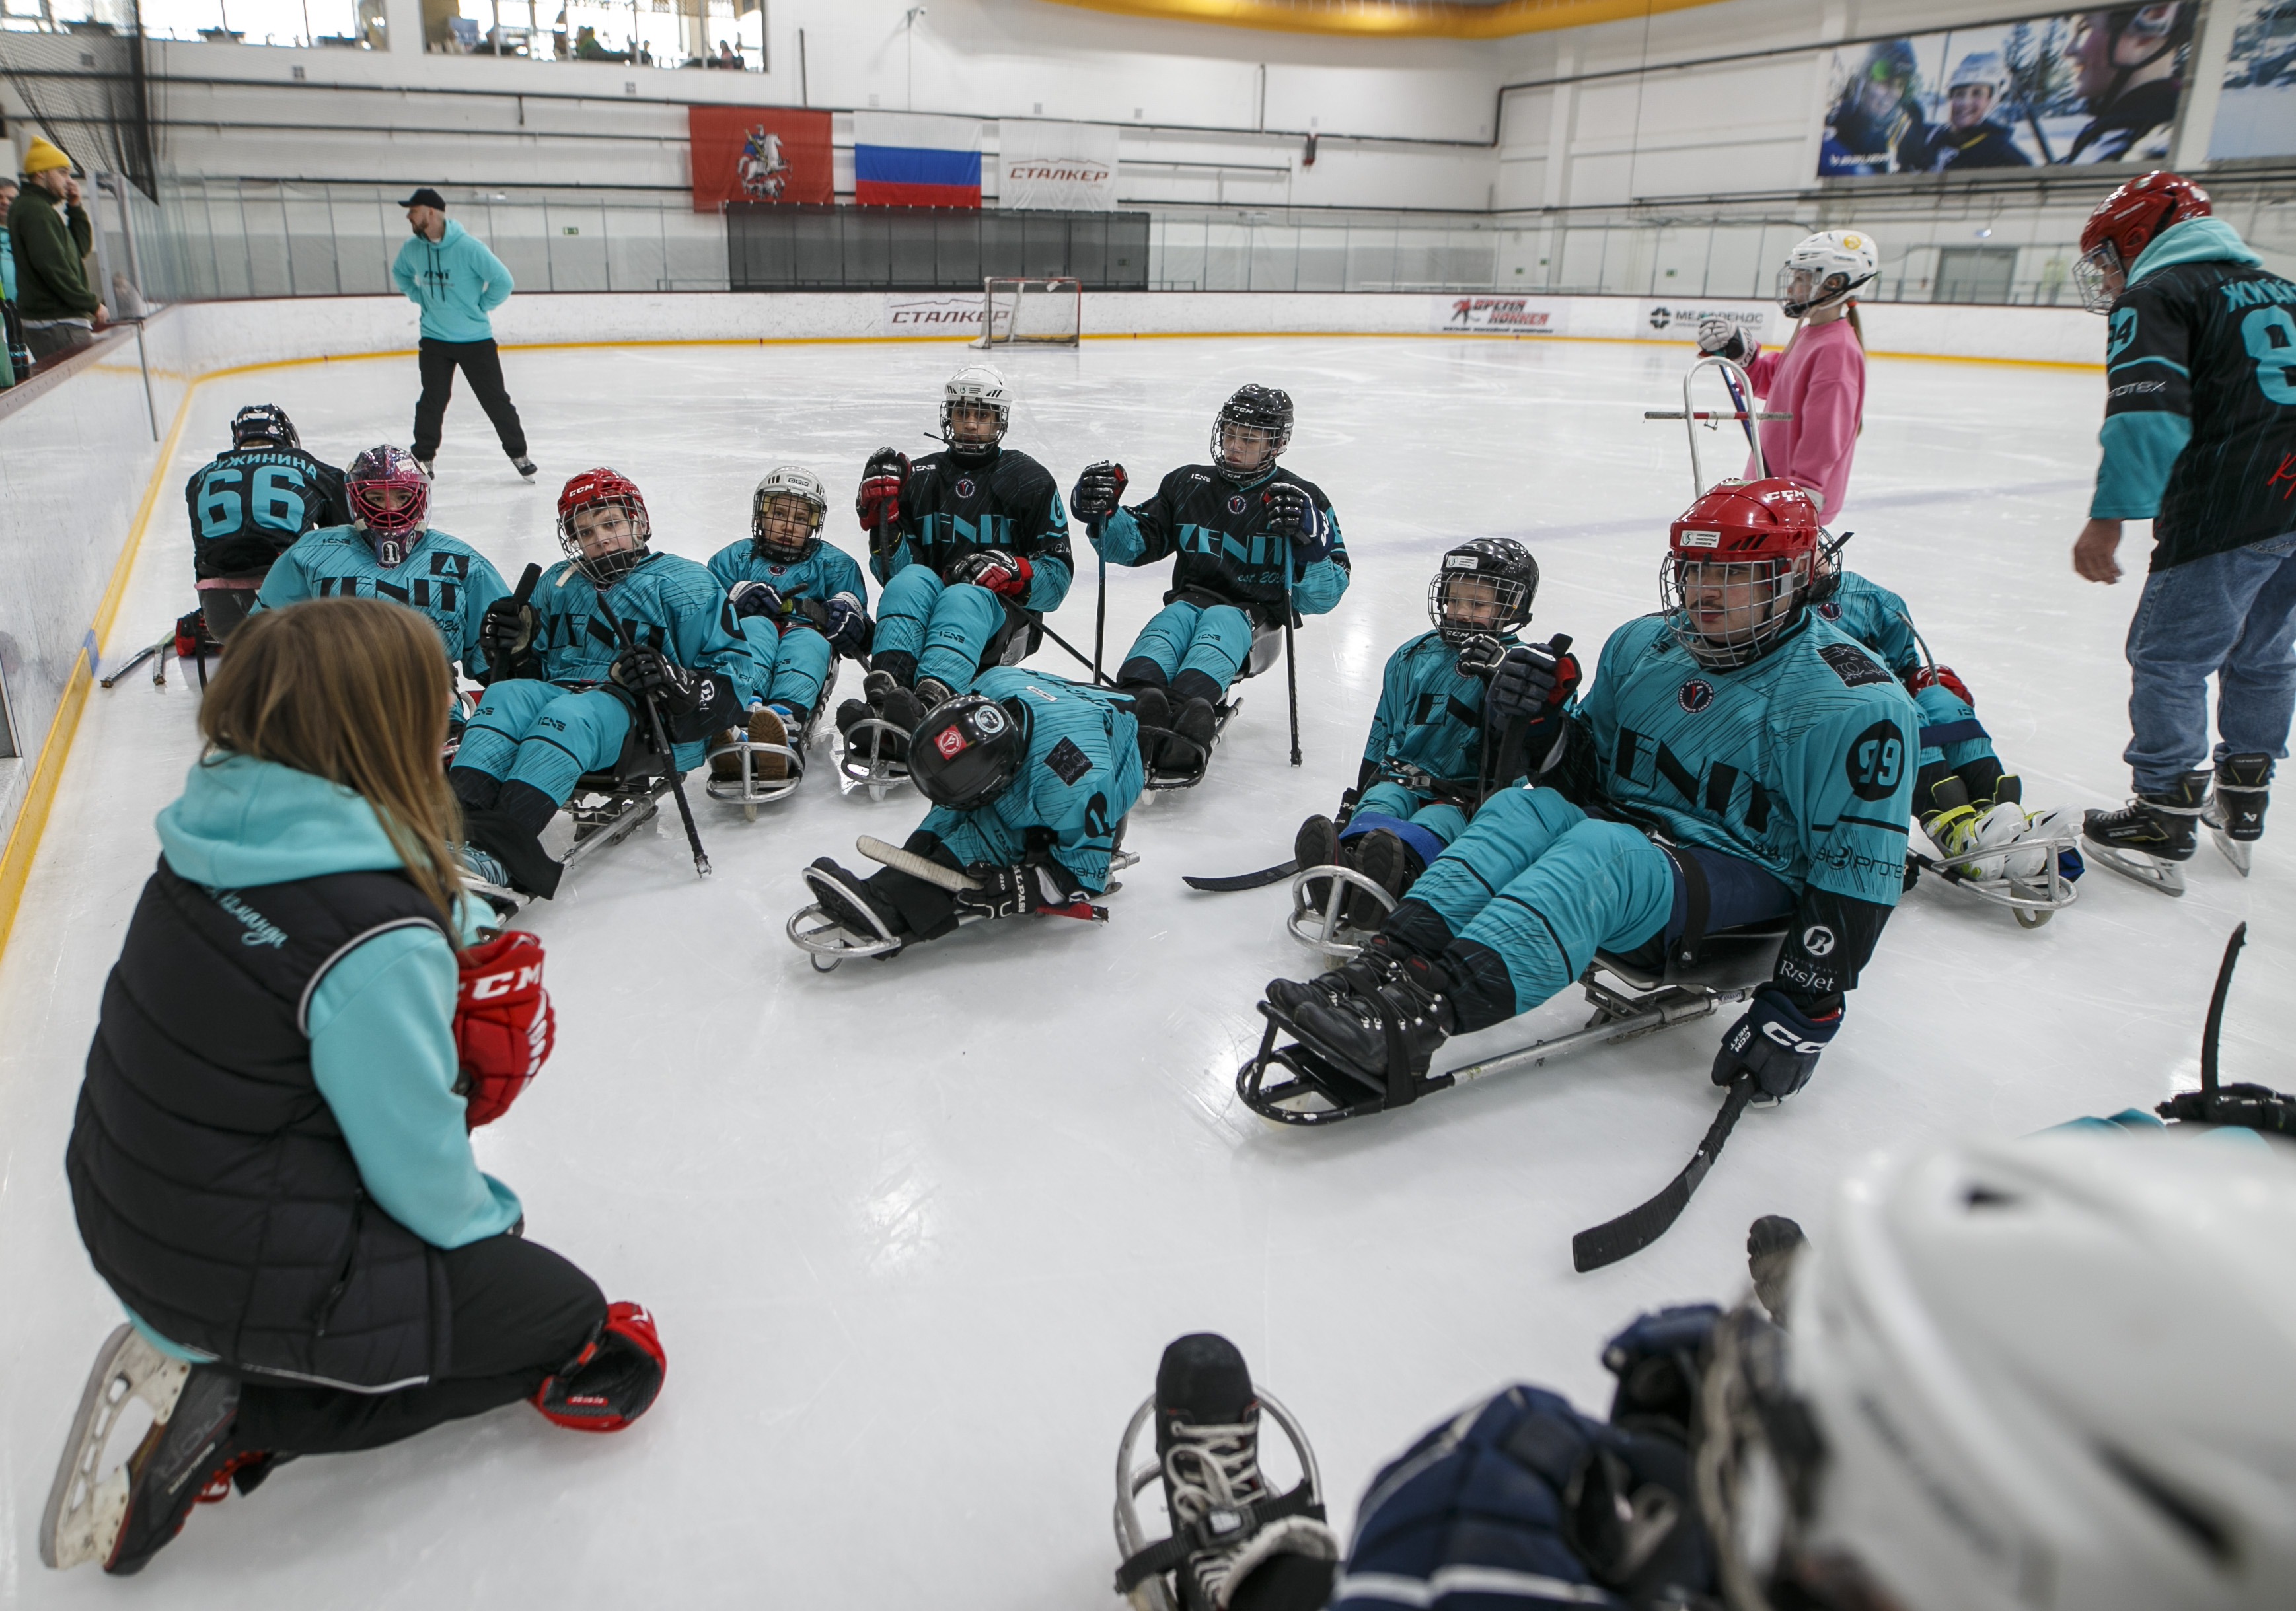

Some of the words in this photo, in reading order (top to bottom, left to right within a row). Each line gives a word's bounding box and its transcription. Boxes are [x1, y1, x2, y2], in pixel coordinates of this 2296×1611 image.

[1010, 168, 1109, 182] СТАЛКЕР
[1473, 299, 1527, 312] ВРЕМЯ
[892, 311, 1009, 324] СТАЛКЕР
[1488, 313, 1549, 325] ХОККЕЯ
[1233, 406, 1254, 414] CCM
[198, 454, 317, 487] ДРУЖИНИНА
[569, 483, 595, 497] CCM
[788, 478, 809, 487] CCM
[198, 465, 305, 538] 66
[1766, 489, 1806, 502] CCM
[385, 544, 396, 561] 1
[1175, 524, 1283, 566] ZENIT
[441, 555, 459, 574] A
[1446, 629, 1470, 638] CCM
[1858, 737, 1902, 787] 99
[1615, 726, 1779, 834] ENIT
[459, 962, 541, 1001] CM
[1730, 1024, 1750, 1050] NEXT
[1734, 1031, 1751, 1053] CCM
[1762, 1021, 1829, 1054] CC
